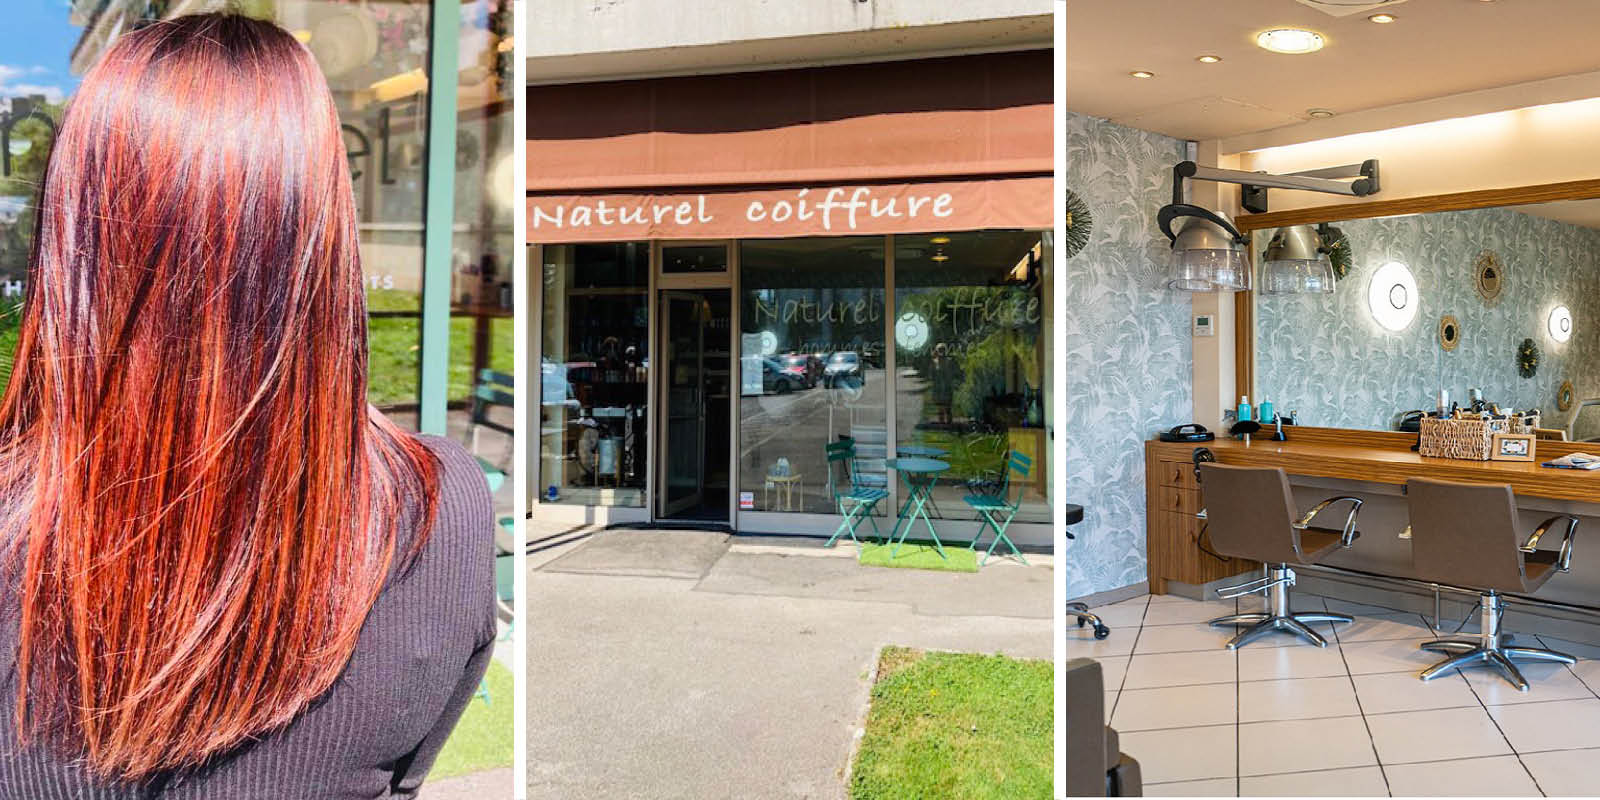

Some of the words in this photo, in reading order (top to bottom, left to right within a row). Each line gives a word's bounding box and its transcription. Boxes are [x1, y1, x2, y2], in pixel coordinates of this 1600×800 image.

[532, 195, 714, 229] Naturel
[745, 187, 955, 230] coiffure
[754, 290, 880, 325] Naturel
[901, 288, 1041, 336] coiffure
